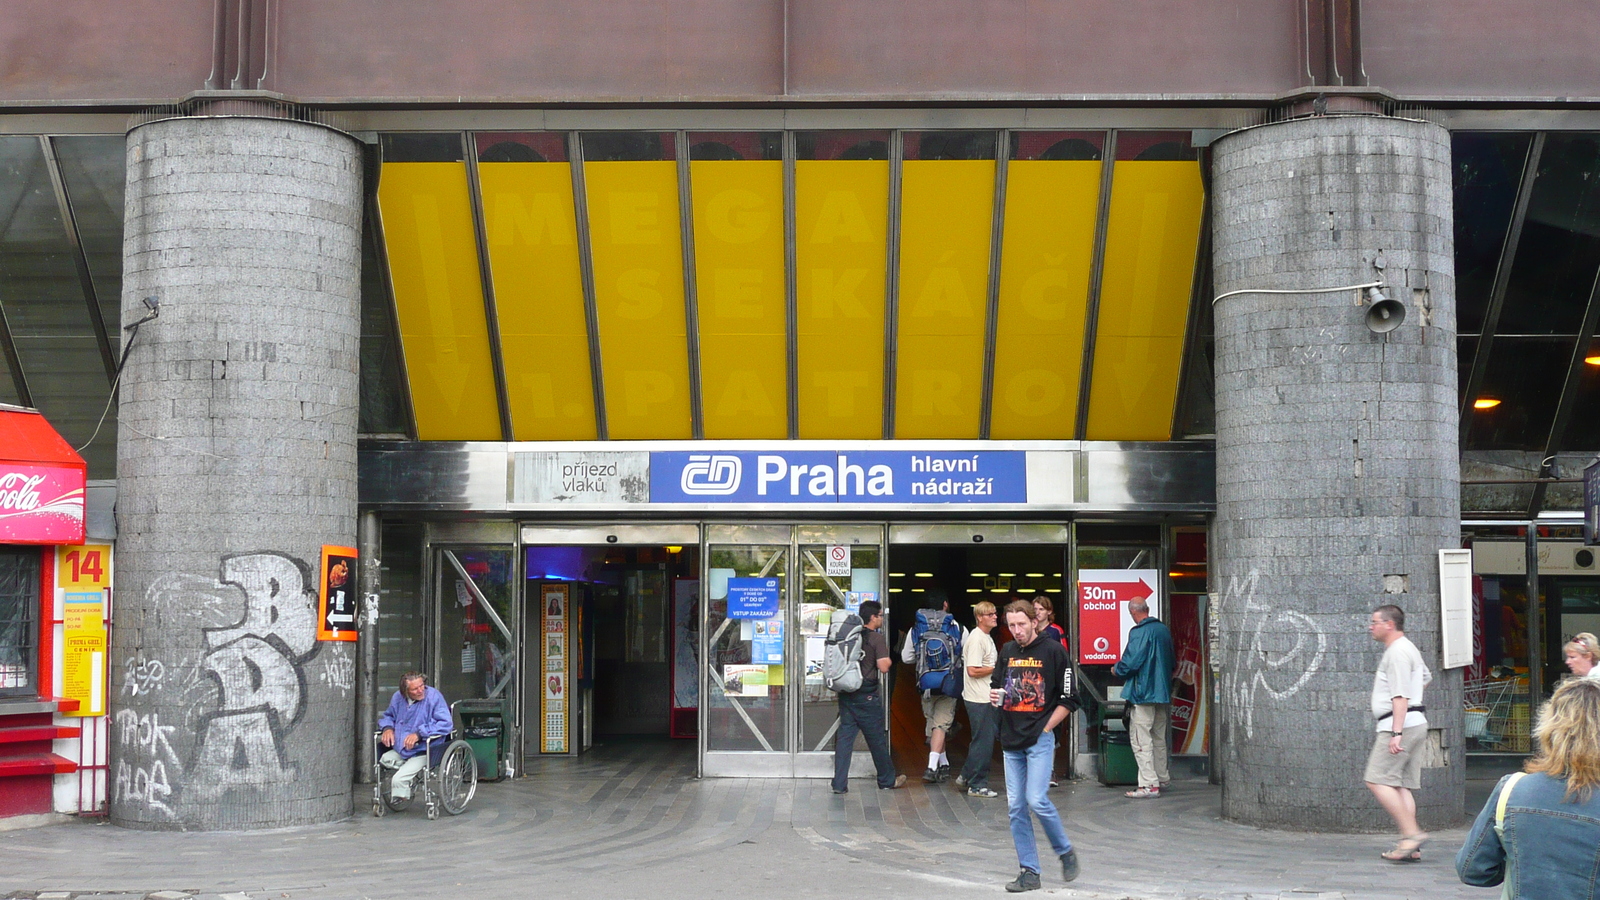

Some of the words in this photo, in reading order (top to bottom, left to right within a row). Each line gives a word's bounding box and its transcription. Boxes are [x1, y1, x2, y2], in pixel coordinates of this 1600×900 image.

[492, 189, 877, 246] MEGA
[615, 250, 1069, 321] SEKÁČ
[520, 372, 586, 419] 1.
[624, 369, 1067, 417] PATRO
[562, 461, 618, 480] příjezd
[911, 455, 980, 472] hlavní
[757, 455, 895, 496] Praha
[562, 478, 607, 493] vlaků
[911, 478, 994, 495] nádraží
[65, 550, 104, 583] 14
[1083, 587, 1116, 600] 30m
[1083, 601, 1116, 610] obchod
[1084, 652, 1117, 660] vodafone
